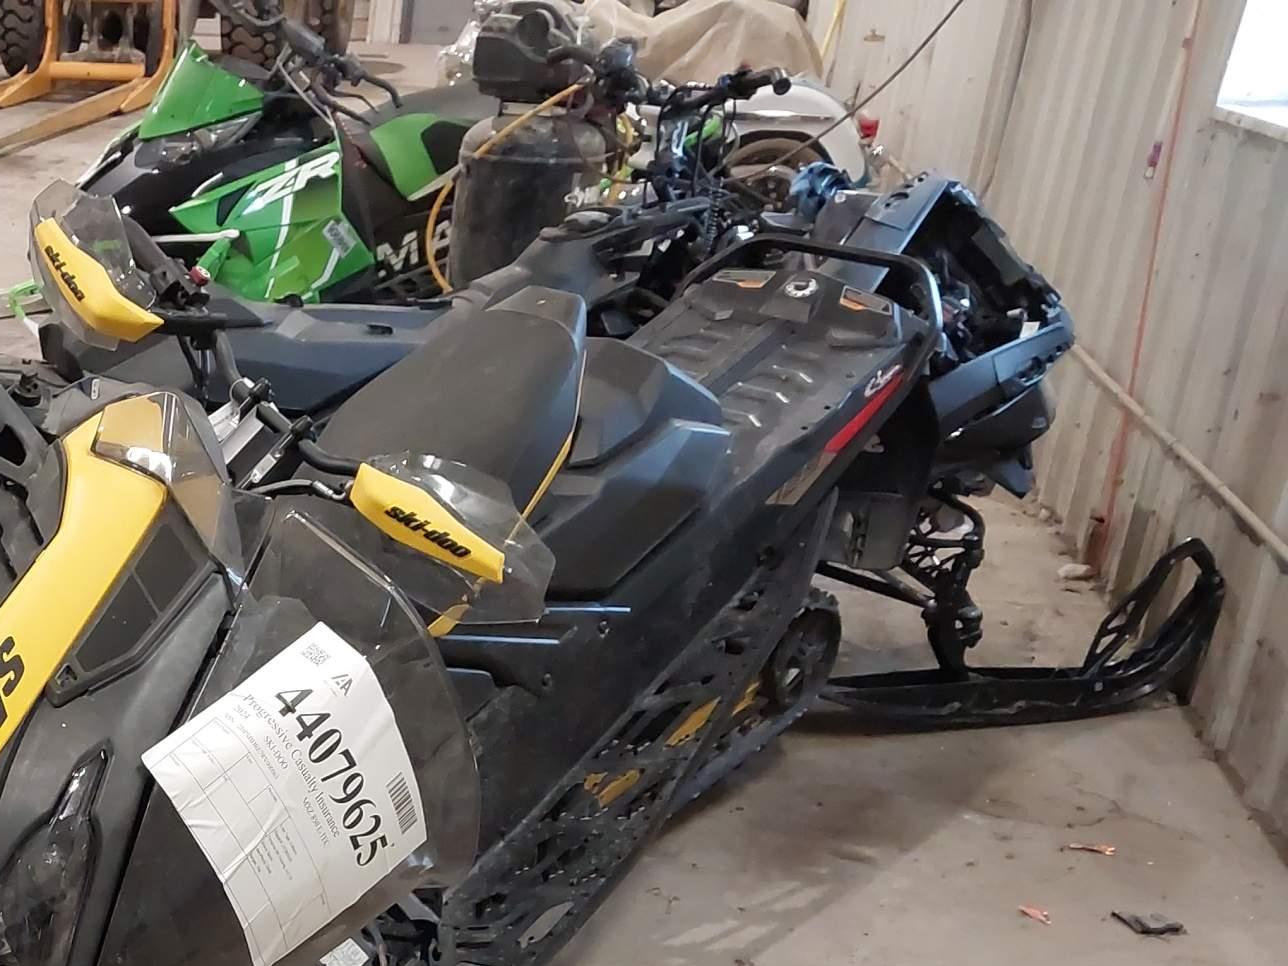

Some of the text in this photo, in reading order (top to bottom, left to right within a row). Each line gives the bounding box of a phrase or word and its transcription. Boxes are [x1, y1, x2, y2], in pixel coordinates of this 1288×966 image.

[242, 151, 340, 215] ZR
[45, 246, 85, 302] ski-doo
[383, 506, 472, 558] ski-doo
[243, 694, 294, 751] Progressive
[290, 748, 318, 795] Casualty
[314, 791, 340, 838] Insurance
[275, 689, 389, 867] 44079625
